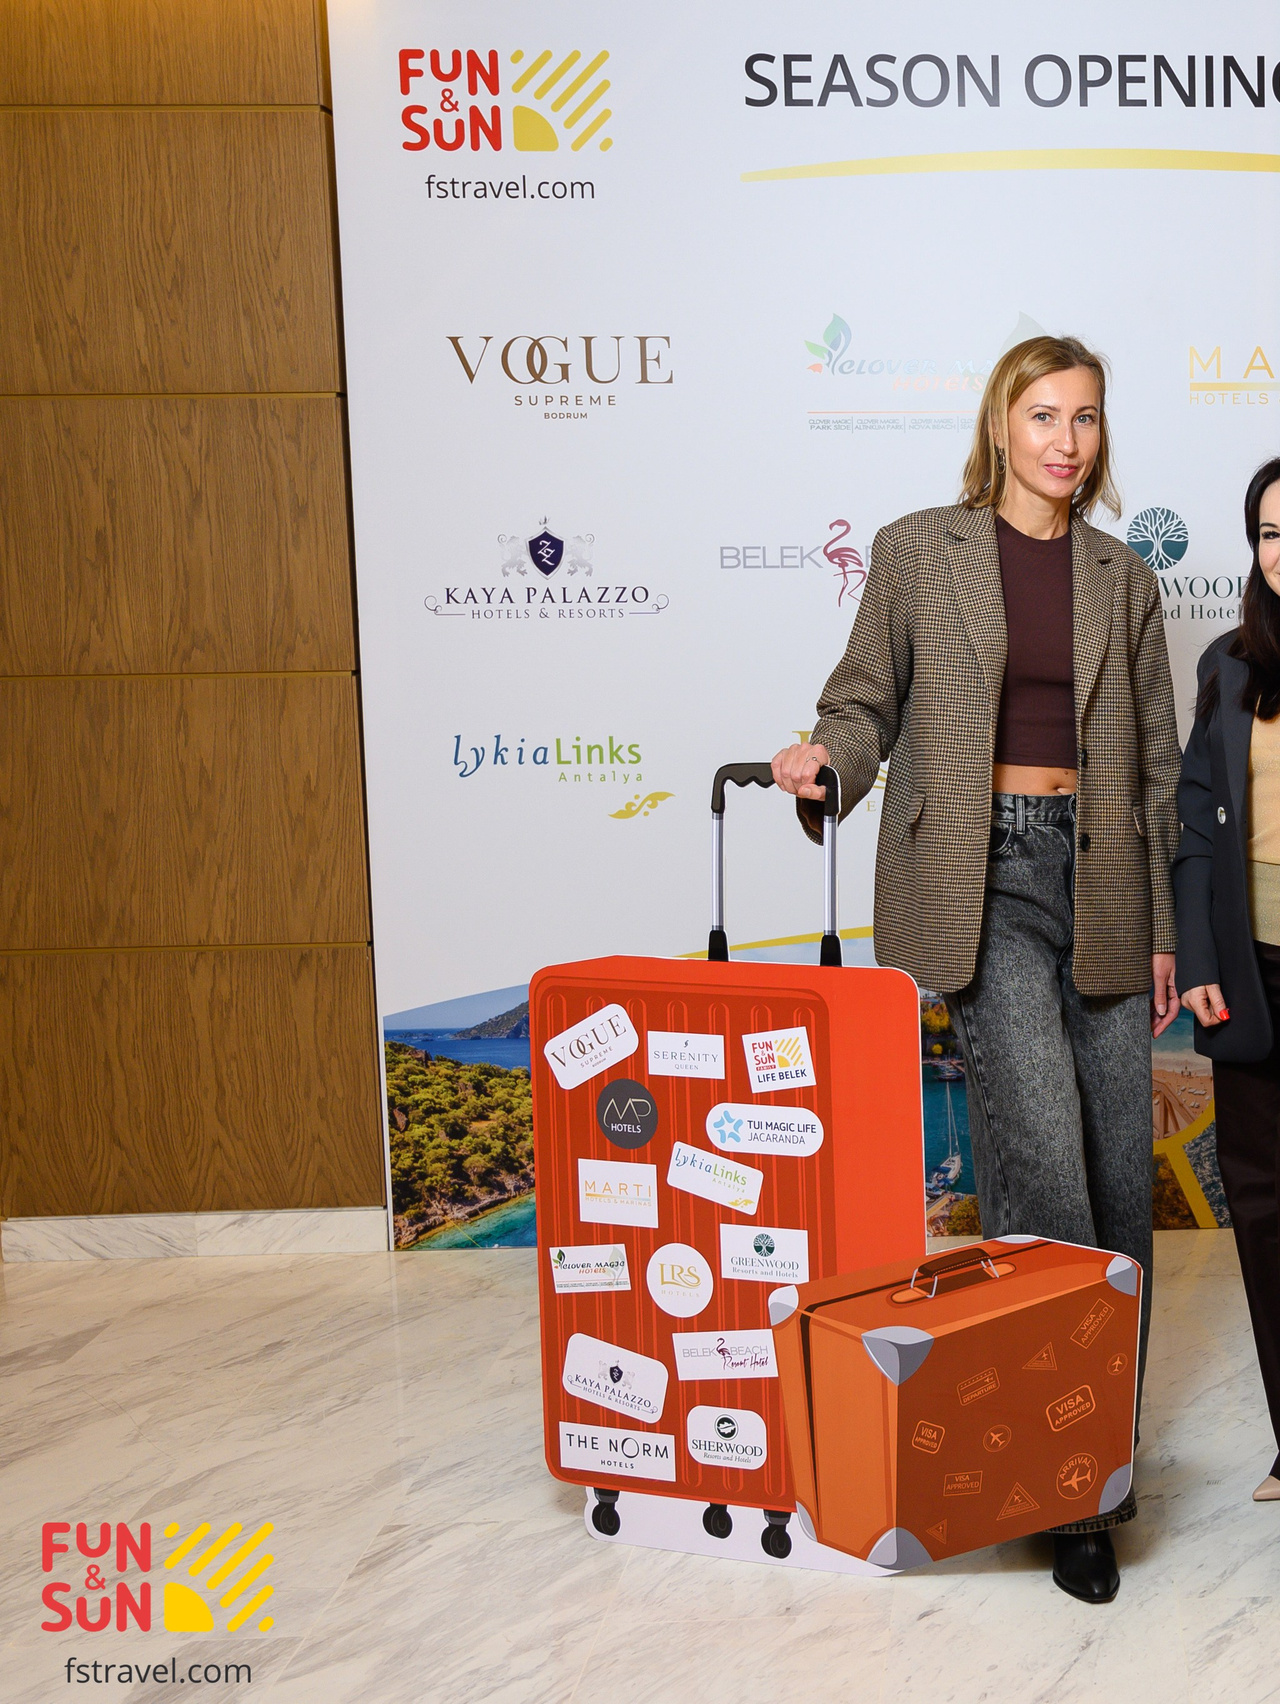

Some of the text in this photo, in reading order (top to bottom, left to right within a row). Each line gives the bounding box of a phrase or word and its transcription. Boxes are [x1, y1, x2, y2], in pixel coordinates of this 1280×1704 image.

[399, 49, 499, 96] FUN
[744, 53, 999, 108] SEASON
[440, 88, 460, 113] &
[401, 105, 502, 151] SUN
[425, 174, 596, 199] fstravel.com
[446, 335, 674, 385] VOGUE
[514, 395, 616, 406] SUPREME
[1189, 392, 1268, 405] HOTELS
[544, 412, 588, 420] BODRUM
[720, 545, 823, 569] BELEK
[445, 585, 650, 605] KAYA PALAZZO
[471, 608, 625, 619] HOTELS & RESORTS
[1163, 605, 1181, 619] nd
[558, 771, 643, 785] Antalya
[550, 1014, 627, 1067] VOGUE
[752, 1040, 773, 1053] FUN
[580, 1046, 614, 1068] SUPREME
[653, 1050, 719, 1062] SERENITY
[754, 1052, 775, 1066] SUN
[757, 1068, 807, 1083] LIFE BELEK
[611, 1123, 641, 1134] HOTELS
[747, 1120, 817, 1134] TUI MAGIC LIFE
[748, 1132, 806, 1145] JACARANDA
[584, 1180, 651, 1197] MARTI
[620, 1199, 652, 1207] MARINAS
[730, 1256, 799, 1271] GREENWOOD
[658, 1263, 701, 1289] LRS
[732, 1267, 758, 1275] Resorts
[775, 1270, 798, 1278] Hotels
[661, 1289, 700, 1298] HOTELS
[1080, 1313, 1096, 1331] VISA
[1080, 1306, 1109, 1344] APPROVED
[682, 1345, 768, 1358] BELEK BEACH
[575, 1374, 651, 1407] KAYA PALAZZO
[963, 1383, 997, 1403] DEPARTURE
[583, 1386, 605, 1398] HOTELS
[615, 1397, 641, 1411] RESORTS
[1055, 1394, 1084, 1415] VISA
[1054, 1401, 1091, 1426] APPROVED
[921, 1427, 937, 1440] VISA
[566, 1433, 669, 1459] THE NORM
[691, 1439, 763, 1456] SHERWOOD
[915, 1437, 938, 1449] APPROVED
[601, 1460, 634, 1469] HOTELS
[1059, 1456, 1092, 1480] ARRIVAL
[946, 1481, 980, 1490] APPROVED
[955, 1474, 969, 1482] VISA
